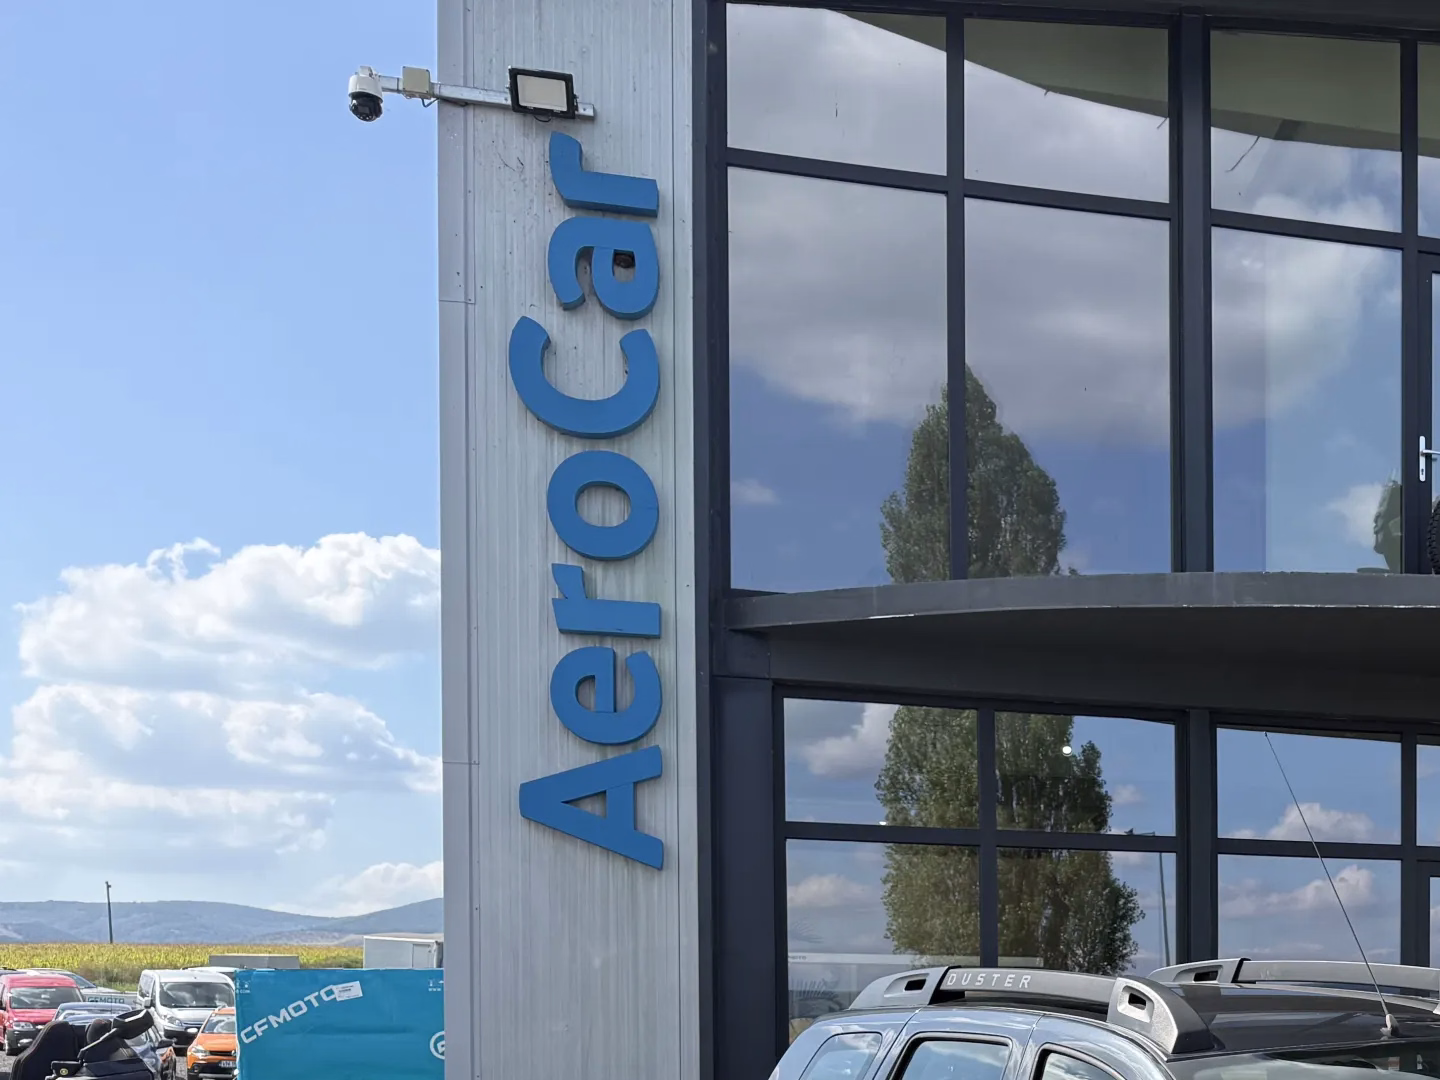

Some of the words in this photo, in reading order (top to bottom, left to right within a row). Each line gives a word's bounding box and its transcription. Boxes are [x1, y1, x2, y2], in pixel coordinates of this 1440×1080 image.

[509, 131, 664, 871] AeroCar
[946, 973, 1032, 988] DUSTER
[240, 985, 337, 1044] CFMOTO
